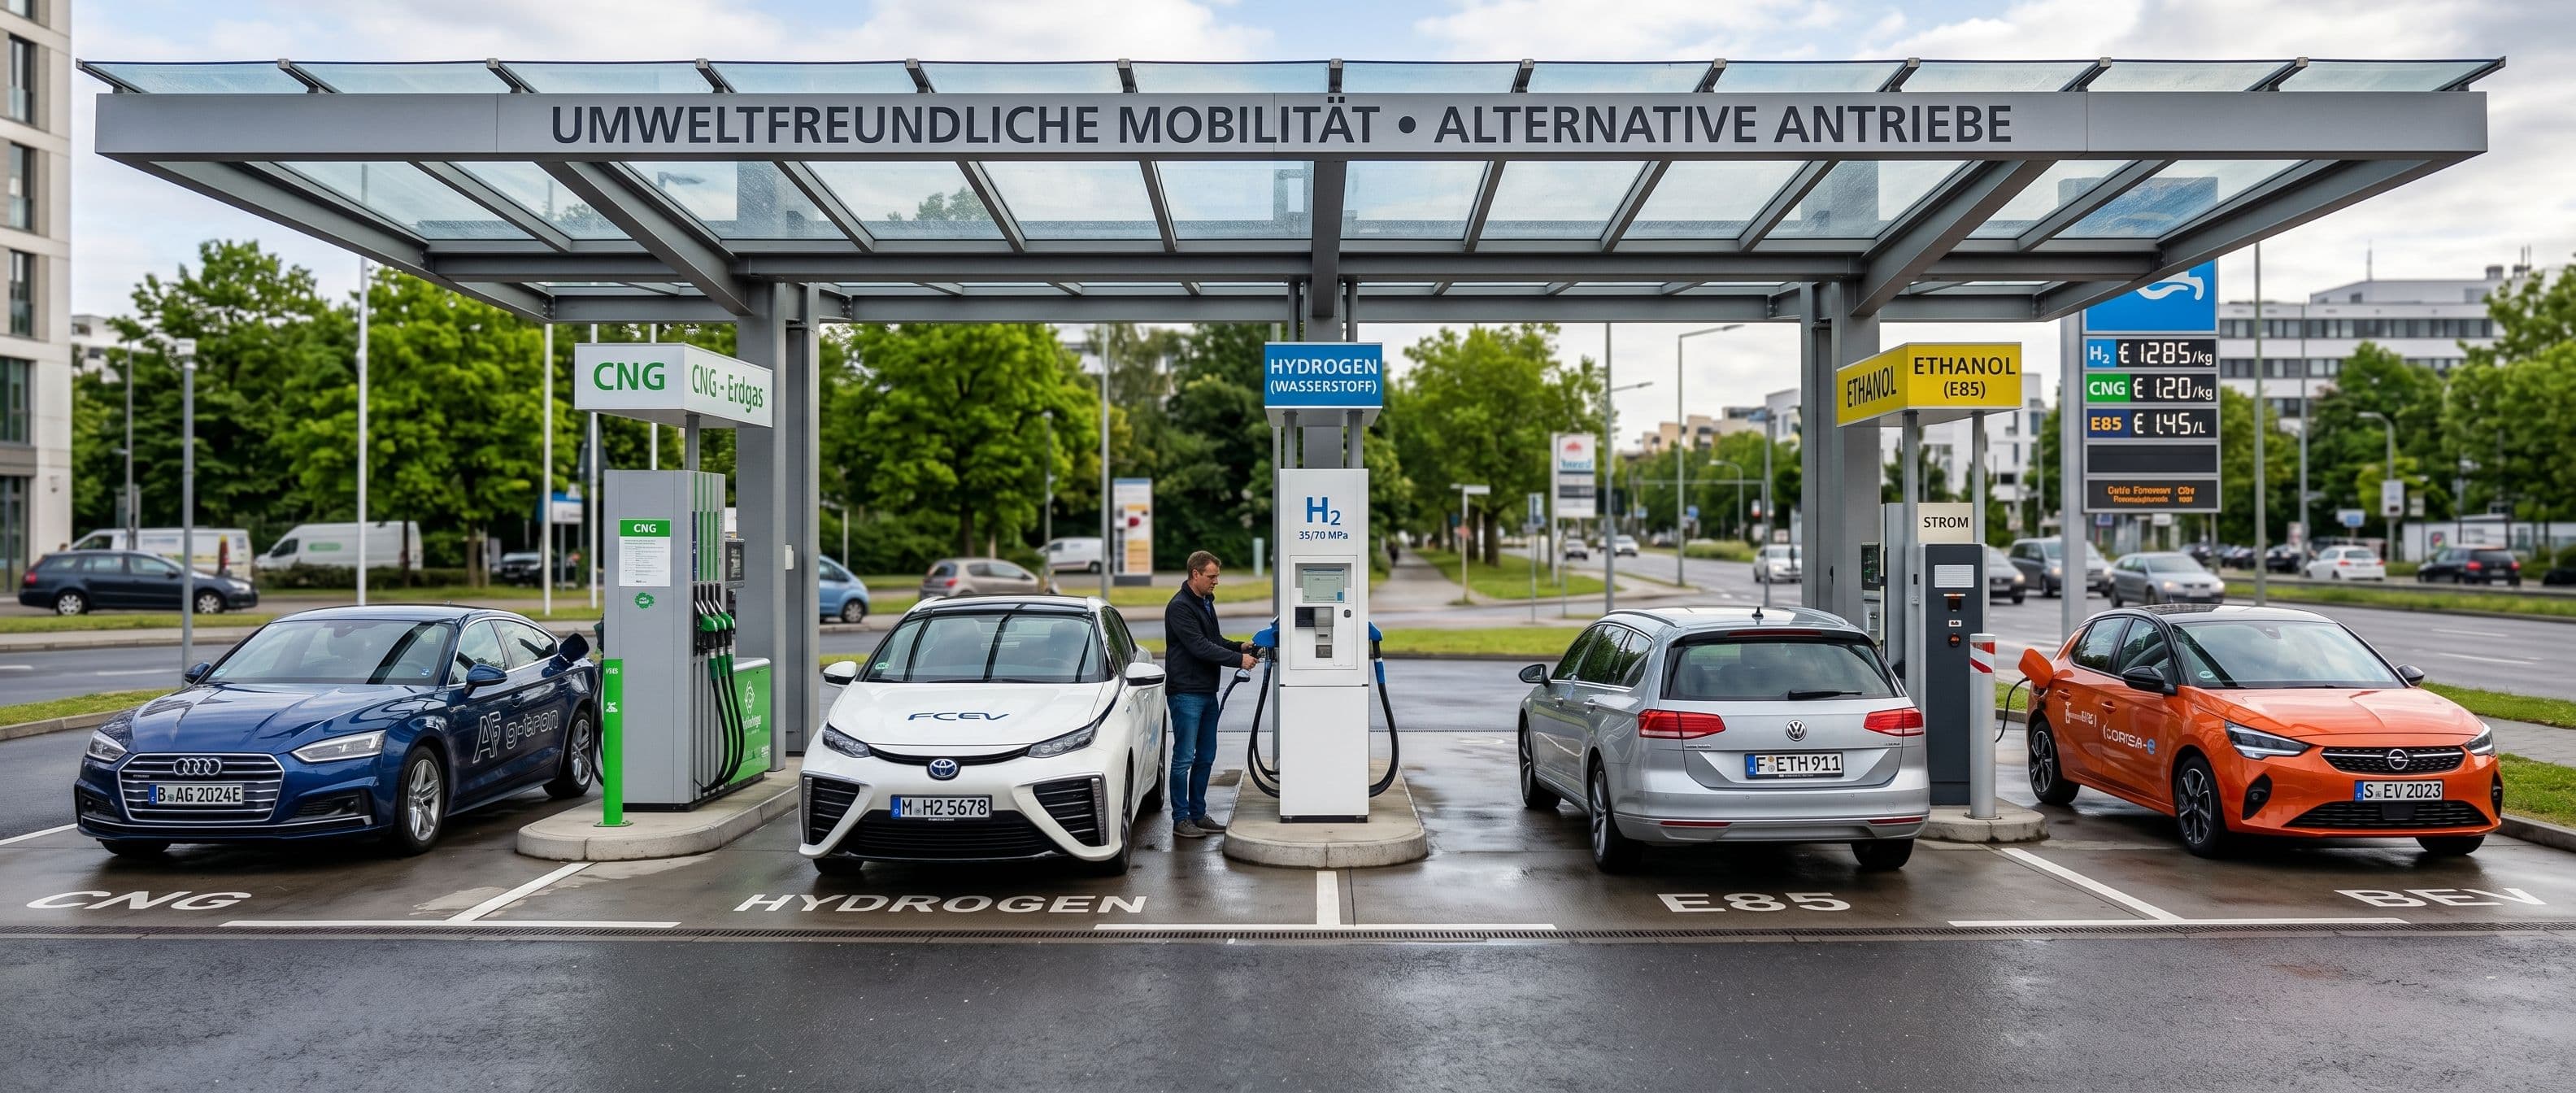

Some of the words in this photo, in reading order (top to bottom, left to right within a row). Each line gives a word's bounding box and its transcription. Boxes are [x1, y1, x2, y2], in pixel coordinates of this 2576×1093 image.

[552, 106, 1099, 144] UMWELTFREUNDLICHE
[1119, 95, 1381, 144] MOBILITÄT
[1434, 105, 1757, 143] ALTERNATIVE
[1774, 105, 2012, 143] ANTRIEBE
[2118, 342, 2130, 364] €
[1270, 358, 1377, 375] HYDROGEN
[1914, 356, 2016, 375] ETHANOL
[593, 362, 665, 391] CNG
[692, 364, 716, 398] CNG
[728, 374, 763, 413] Erdgas
[1270, 380, 1377, 394] (WASSERSTOFF)
[1847, 365, 1896, 408] ETHANOL
[1943, 381, 1986, 399] (E85)
[2089, 381, 2126, 396] CNG
[2133, 377, 2143, 398] €
[2091, 416, 2122, 431] E85
[2133, 413, 2144, 434] €
[633, 523, 657, 533] CNG
[1923, 516, 1969, 529] STROM
[1299, 530, 1326, 542] 35/70
[1328, 530, 1349, 540] MPa
[907, 712, 1010, 721] FCEV
[506, 709, 559, 750] g-tron
[1756, 756, 1766, 773] F
[1776, 756, 1809, 772] ETH
[1812, 756, 1841, 772] 911
[158, 786, 166, 803] B
[175, 786, 194, 803] AG
[196, 786, 242, 803] 2024E
[2364, 783, 2374, 799] S
[2383, 783, 2404, 799] EV
[2406, 783, 2441, 799] 2023
[902, 799, 912, 816] M
[923, 799, 943, 816] H2
[946, 799, 987, 816] 5678
[26, 891, 252, 910] CNG
[732, 894, 1148, 912] HYDROGEN
[1656, 892, 1852, 912] E85
[2334, 887, 2548, 908] BEV
